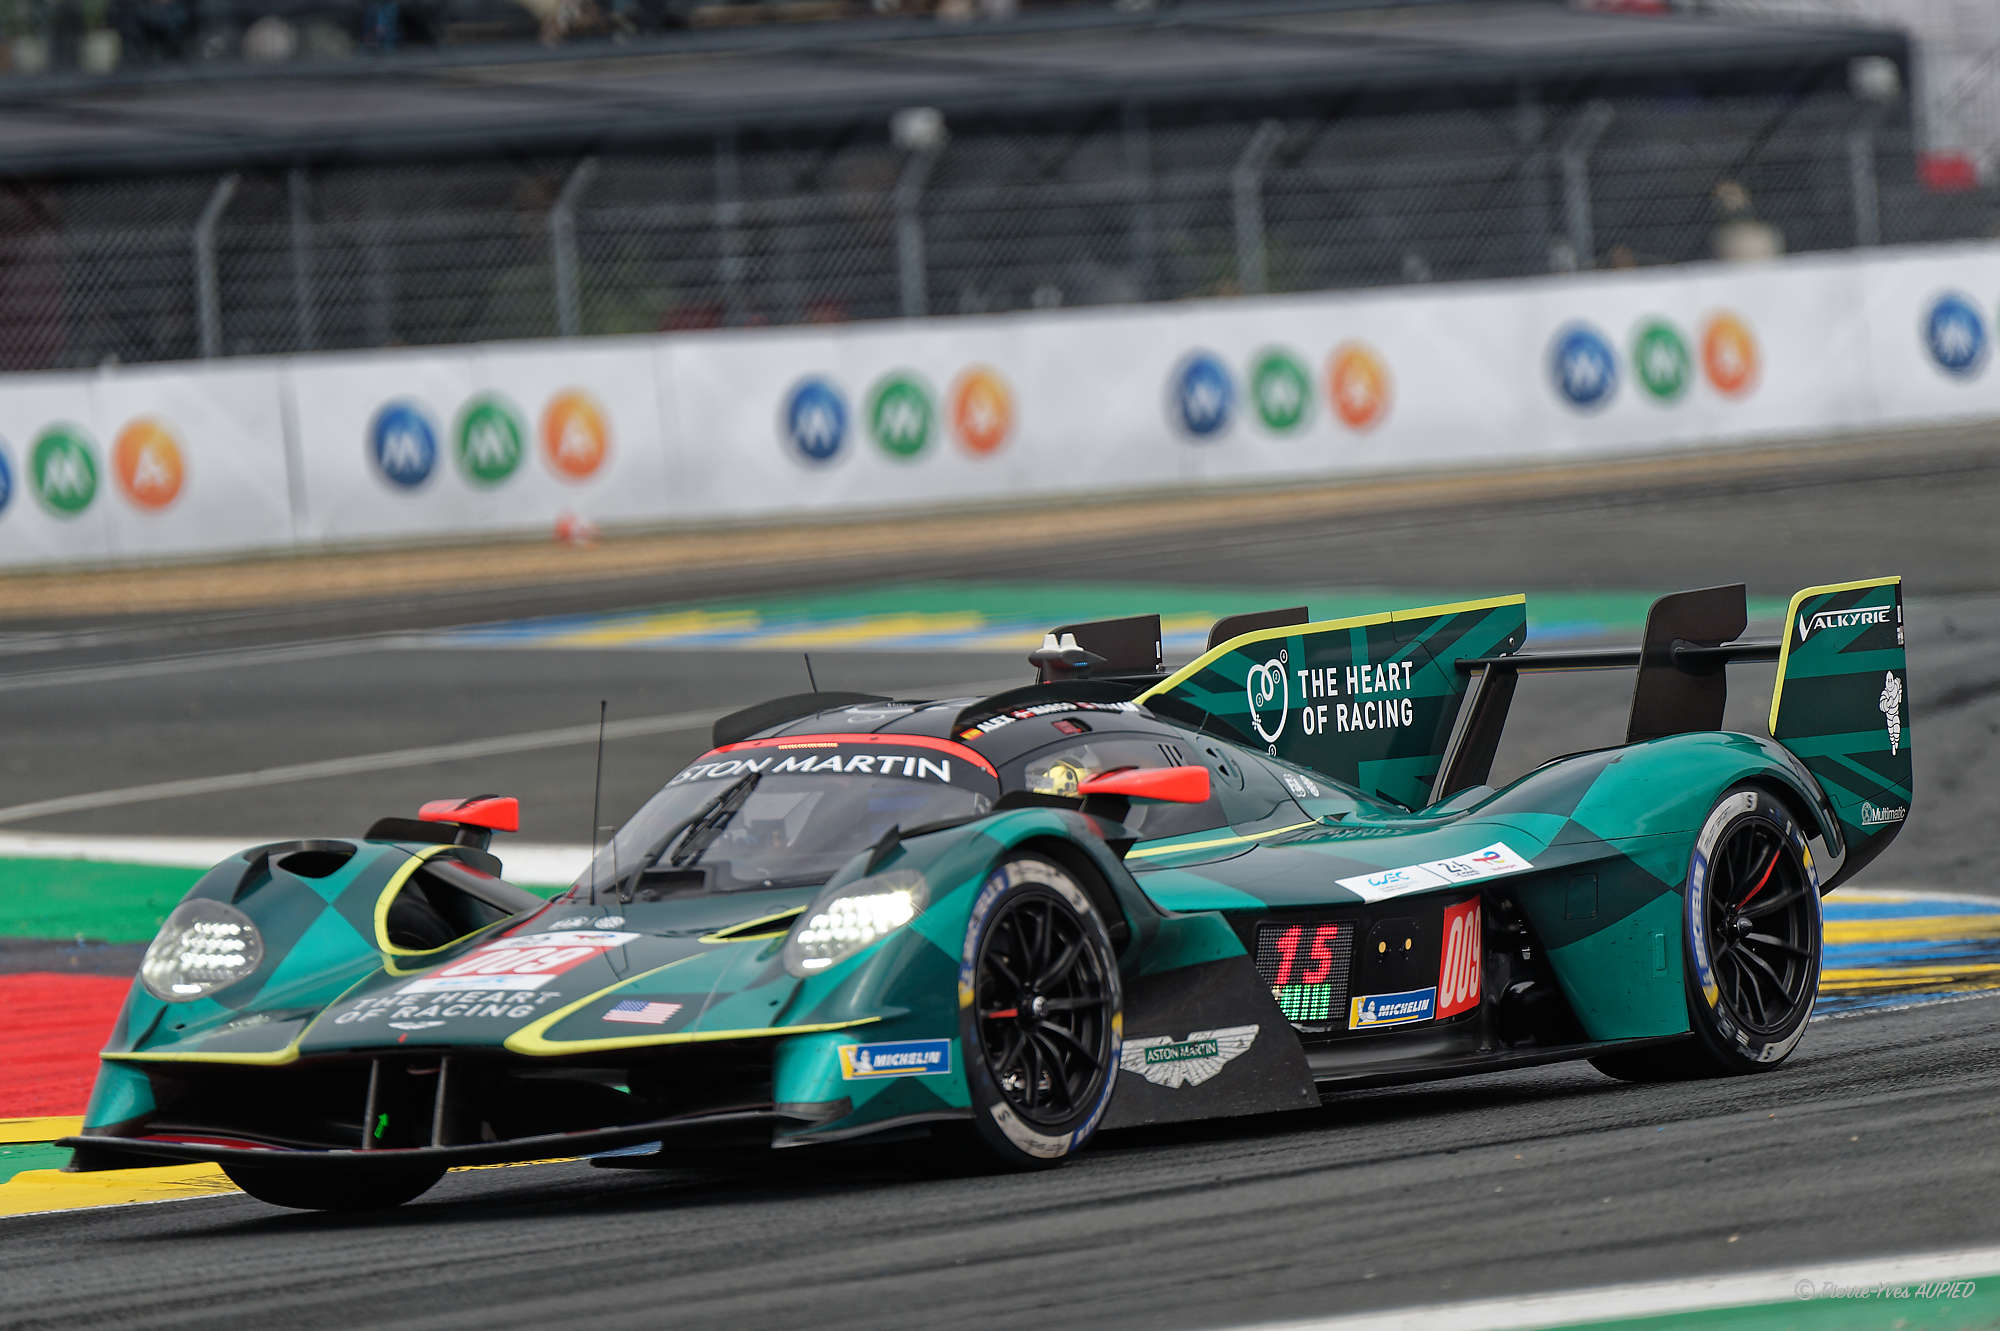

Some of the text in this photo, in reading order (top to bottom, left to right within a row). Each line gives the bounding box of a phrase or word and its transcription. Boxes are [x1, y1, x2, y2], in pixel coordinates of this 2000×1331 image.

[1799, 605, 1890, 642] VALKYRIE
[1297, 661, 1413, 699] THE HEART
[1302, 698, 1413, 735] OF RACING
[669, 755, 951, 786] STON MARTIN
[1872, 805, 1906, 822] Multimatic
[439, 947, 596, 977] 009
[1274, 925, 1338, 985] 15
[1440, 905, 1482, 1009] 009
[334, 1004, 536, 1025] OF RACING
[352, 991, 562, 1010] THE HEART
[1377, 998, 1431, 1018] MICHELIN
[873, 1051, 942, 1067] MICHELIN
[1147, 1042, 1218, 1062] ASTON MARTIN
